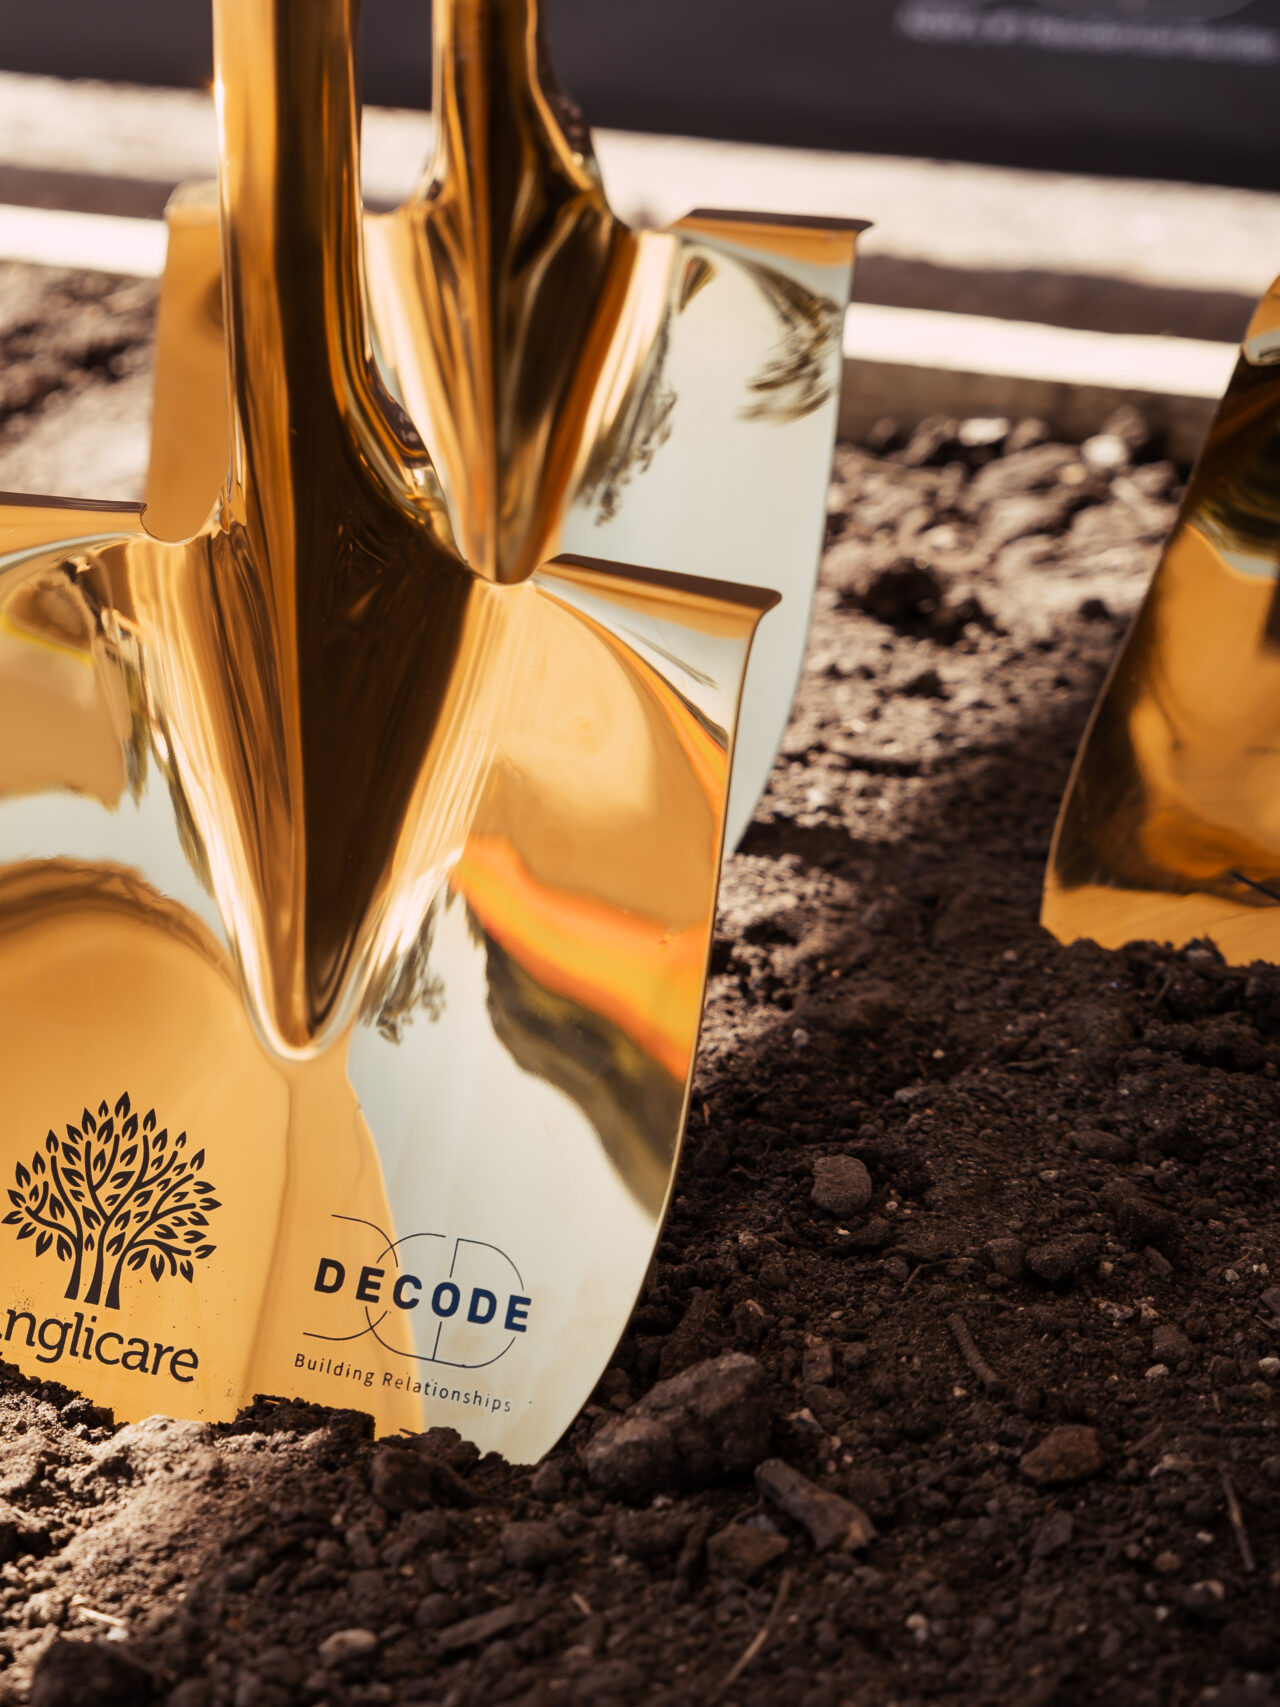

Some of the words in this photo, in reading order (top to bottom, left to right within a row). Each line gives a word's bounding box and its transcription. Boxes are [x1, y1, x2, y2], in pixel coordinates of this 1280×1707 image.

[314, 1257, 532, 1332] DECODE
[294, 1352, 374, 1387] Building
[382, 1371, 511, 1413] Relationships
